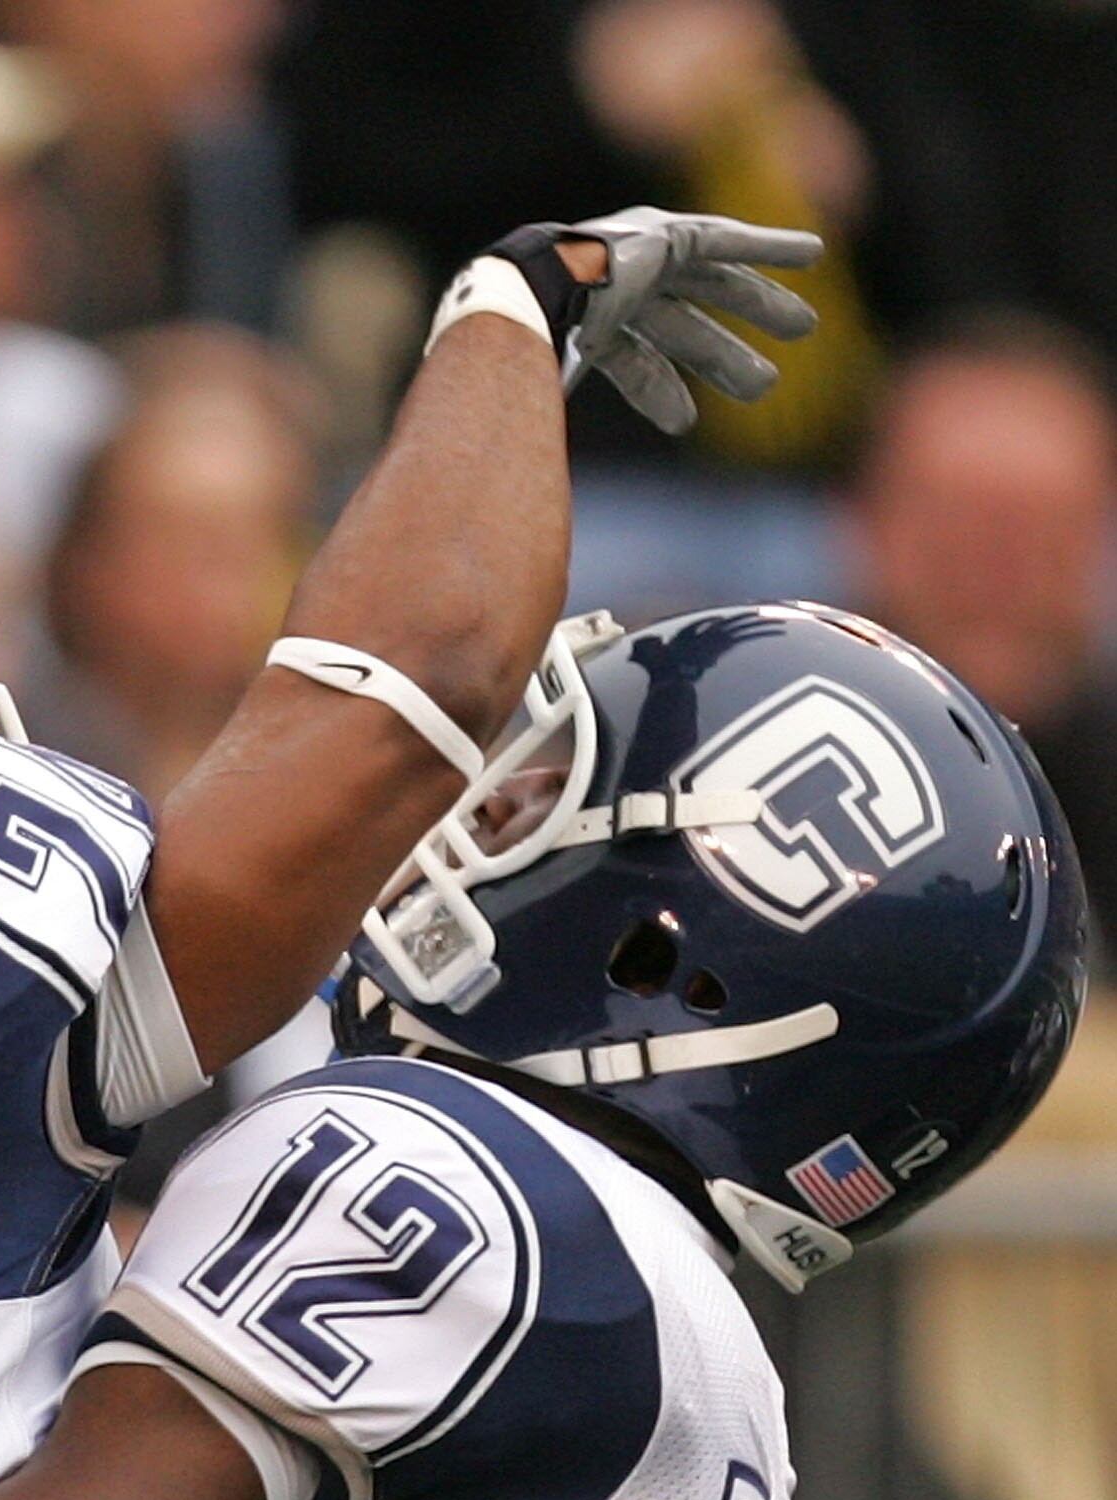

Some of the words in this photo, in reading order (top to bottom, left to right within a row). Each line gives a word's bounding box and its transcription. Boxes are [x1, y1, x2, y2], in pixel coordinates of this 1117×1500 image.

[669, 673, 947, 934] C
[181, 1108, 490, 1402] 12
[891, 1128, 950, 1181] 12
